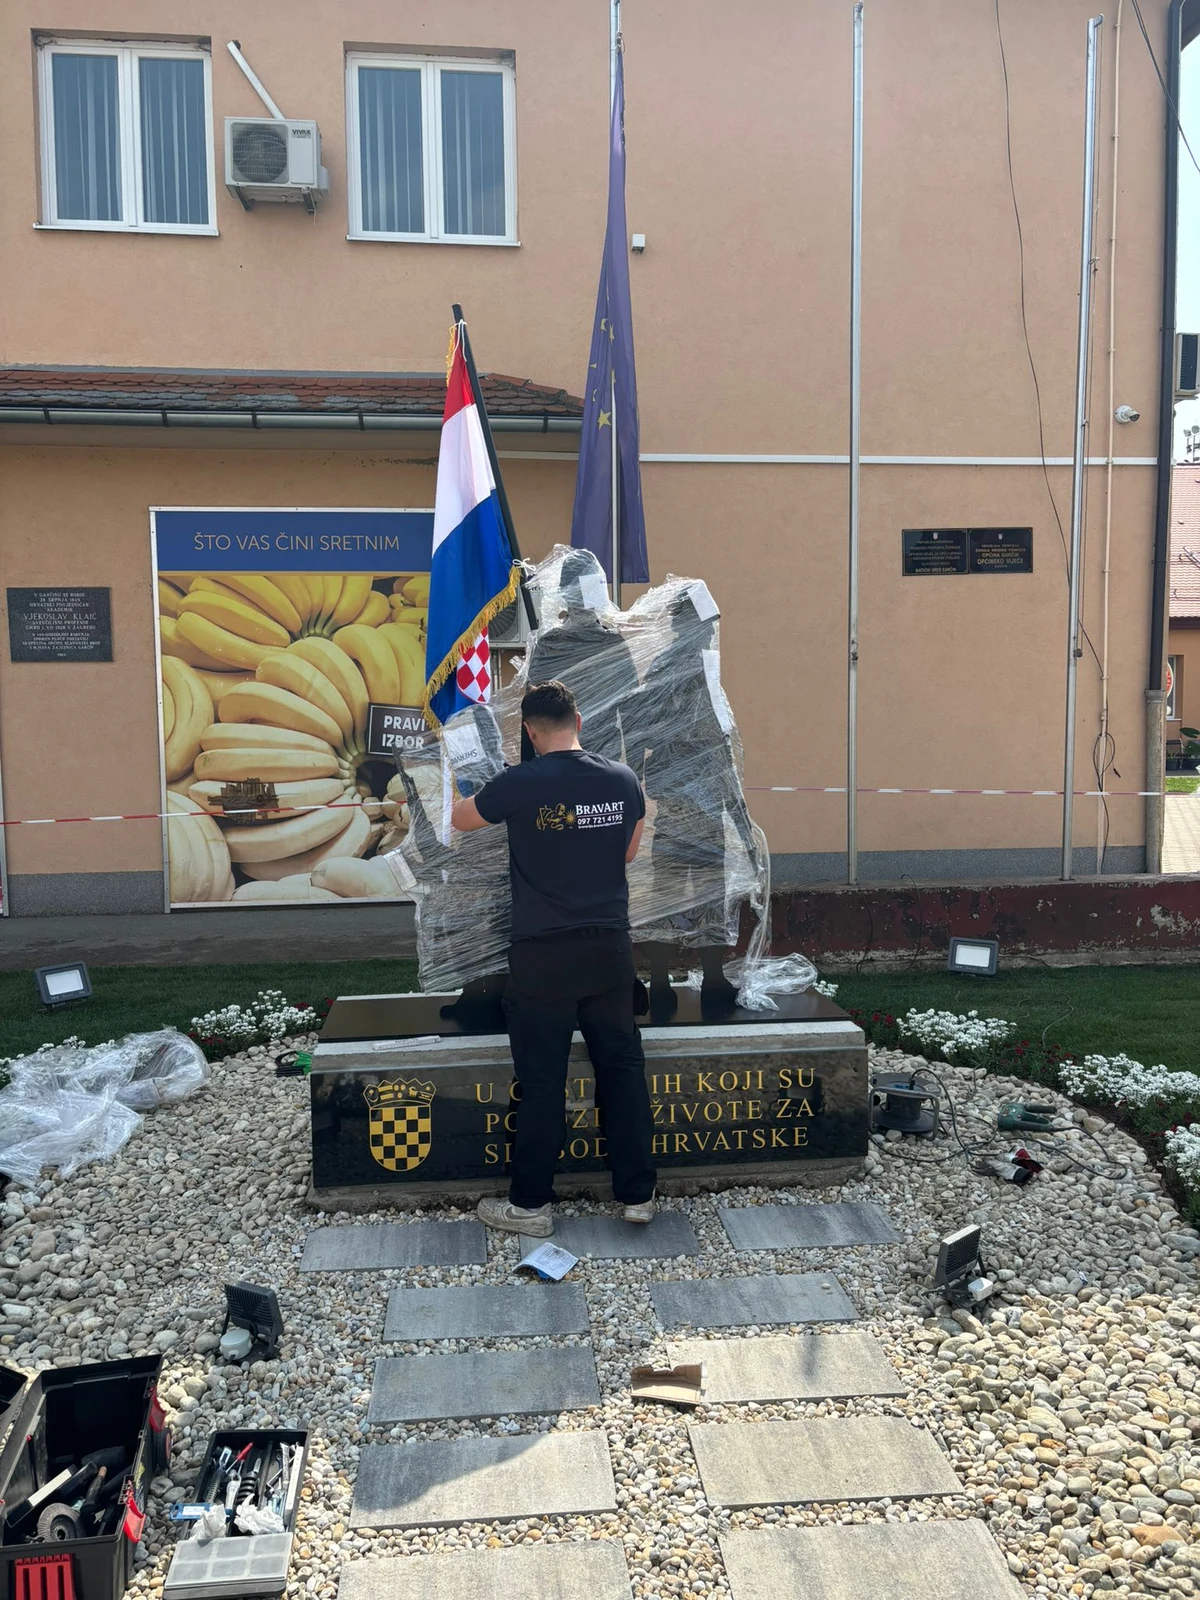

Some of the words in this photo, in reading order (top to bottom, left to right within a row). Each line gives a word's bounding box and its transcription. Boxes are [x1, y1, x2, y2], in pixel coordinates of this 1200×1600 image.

[194, 532, 231, 550] ŠTO
[236, 535, 270, 550] VAS
[275, 532, 314, 550] ČINI
[320, 535, 400, 551] SRETNIM
[23, 612, 67, 620] VJEKOSLAV
[73, 612, 97, 620] KLAIĆ
[383, 715, 426, 731] PRAVI
[381, 733, 425, 749] IZBOR
[577, 817, 591, 825] 097
[592, 816, 606, 824] 721
[607, 814, 623, 822] 4195
[474, 1082, 495, 1103] U
[651, 1073, 682, 1094] IH
[697, 1070, 764, 1092] KOJI
[778, 1068, 815, 1089] SU
[650, 1098, 763, 1125] ŽIVOTE
[776, 1097, 815, 1119] ZA
[651, 1126, 809, 1154] HRVATSKE
